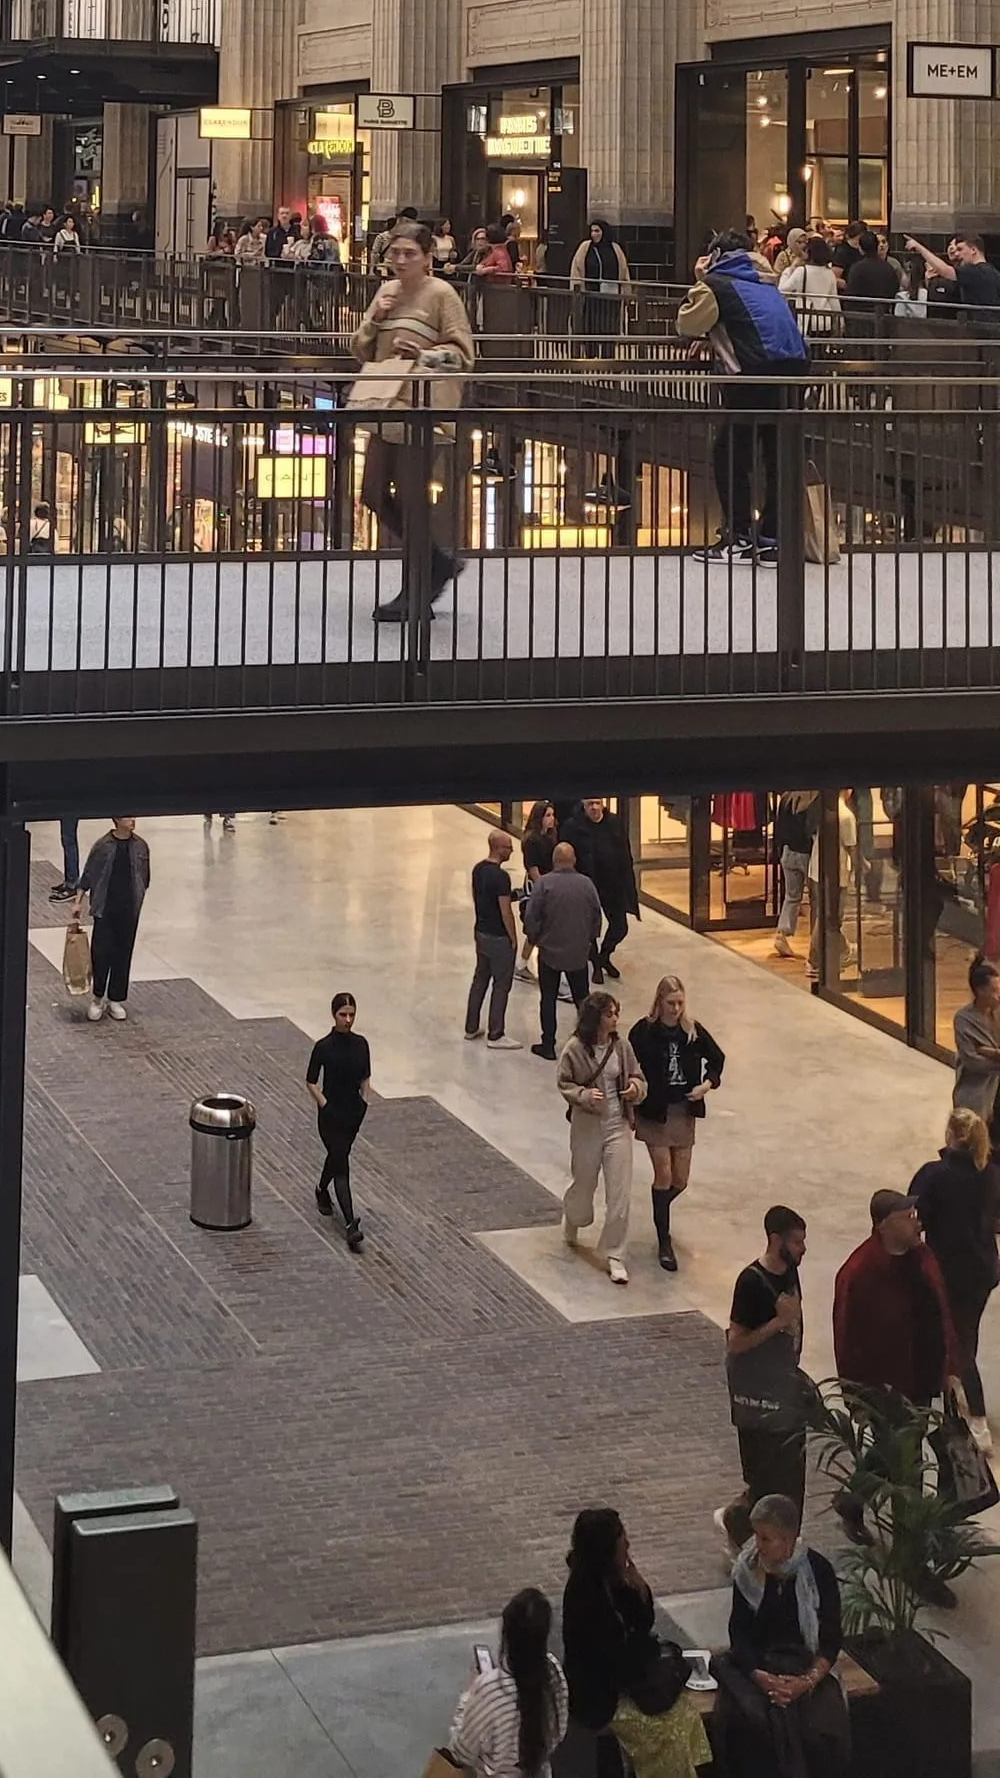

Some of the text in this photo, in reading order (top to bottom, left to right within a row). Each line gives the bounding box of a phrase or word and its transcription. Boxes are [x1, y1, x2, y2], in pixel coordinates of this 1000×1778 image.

[928, 64, 978, 79] ME+EM
[500, 115, 538, 135] PARIS
[487, 136, 551, 156] BAGUETTE
